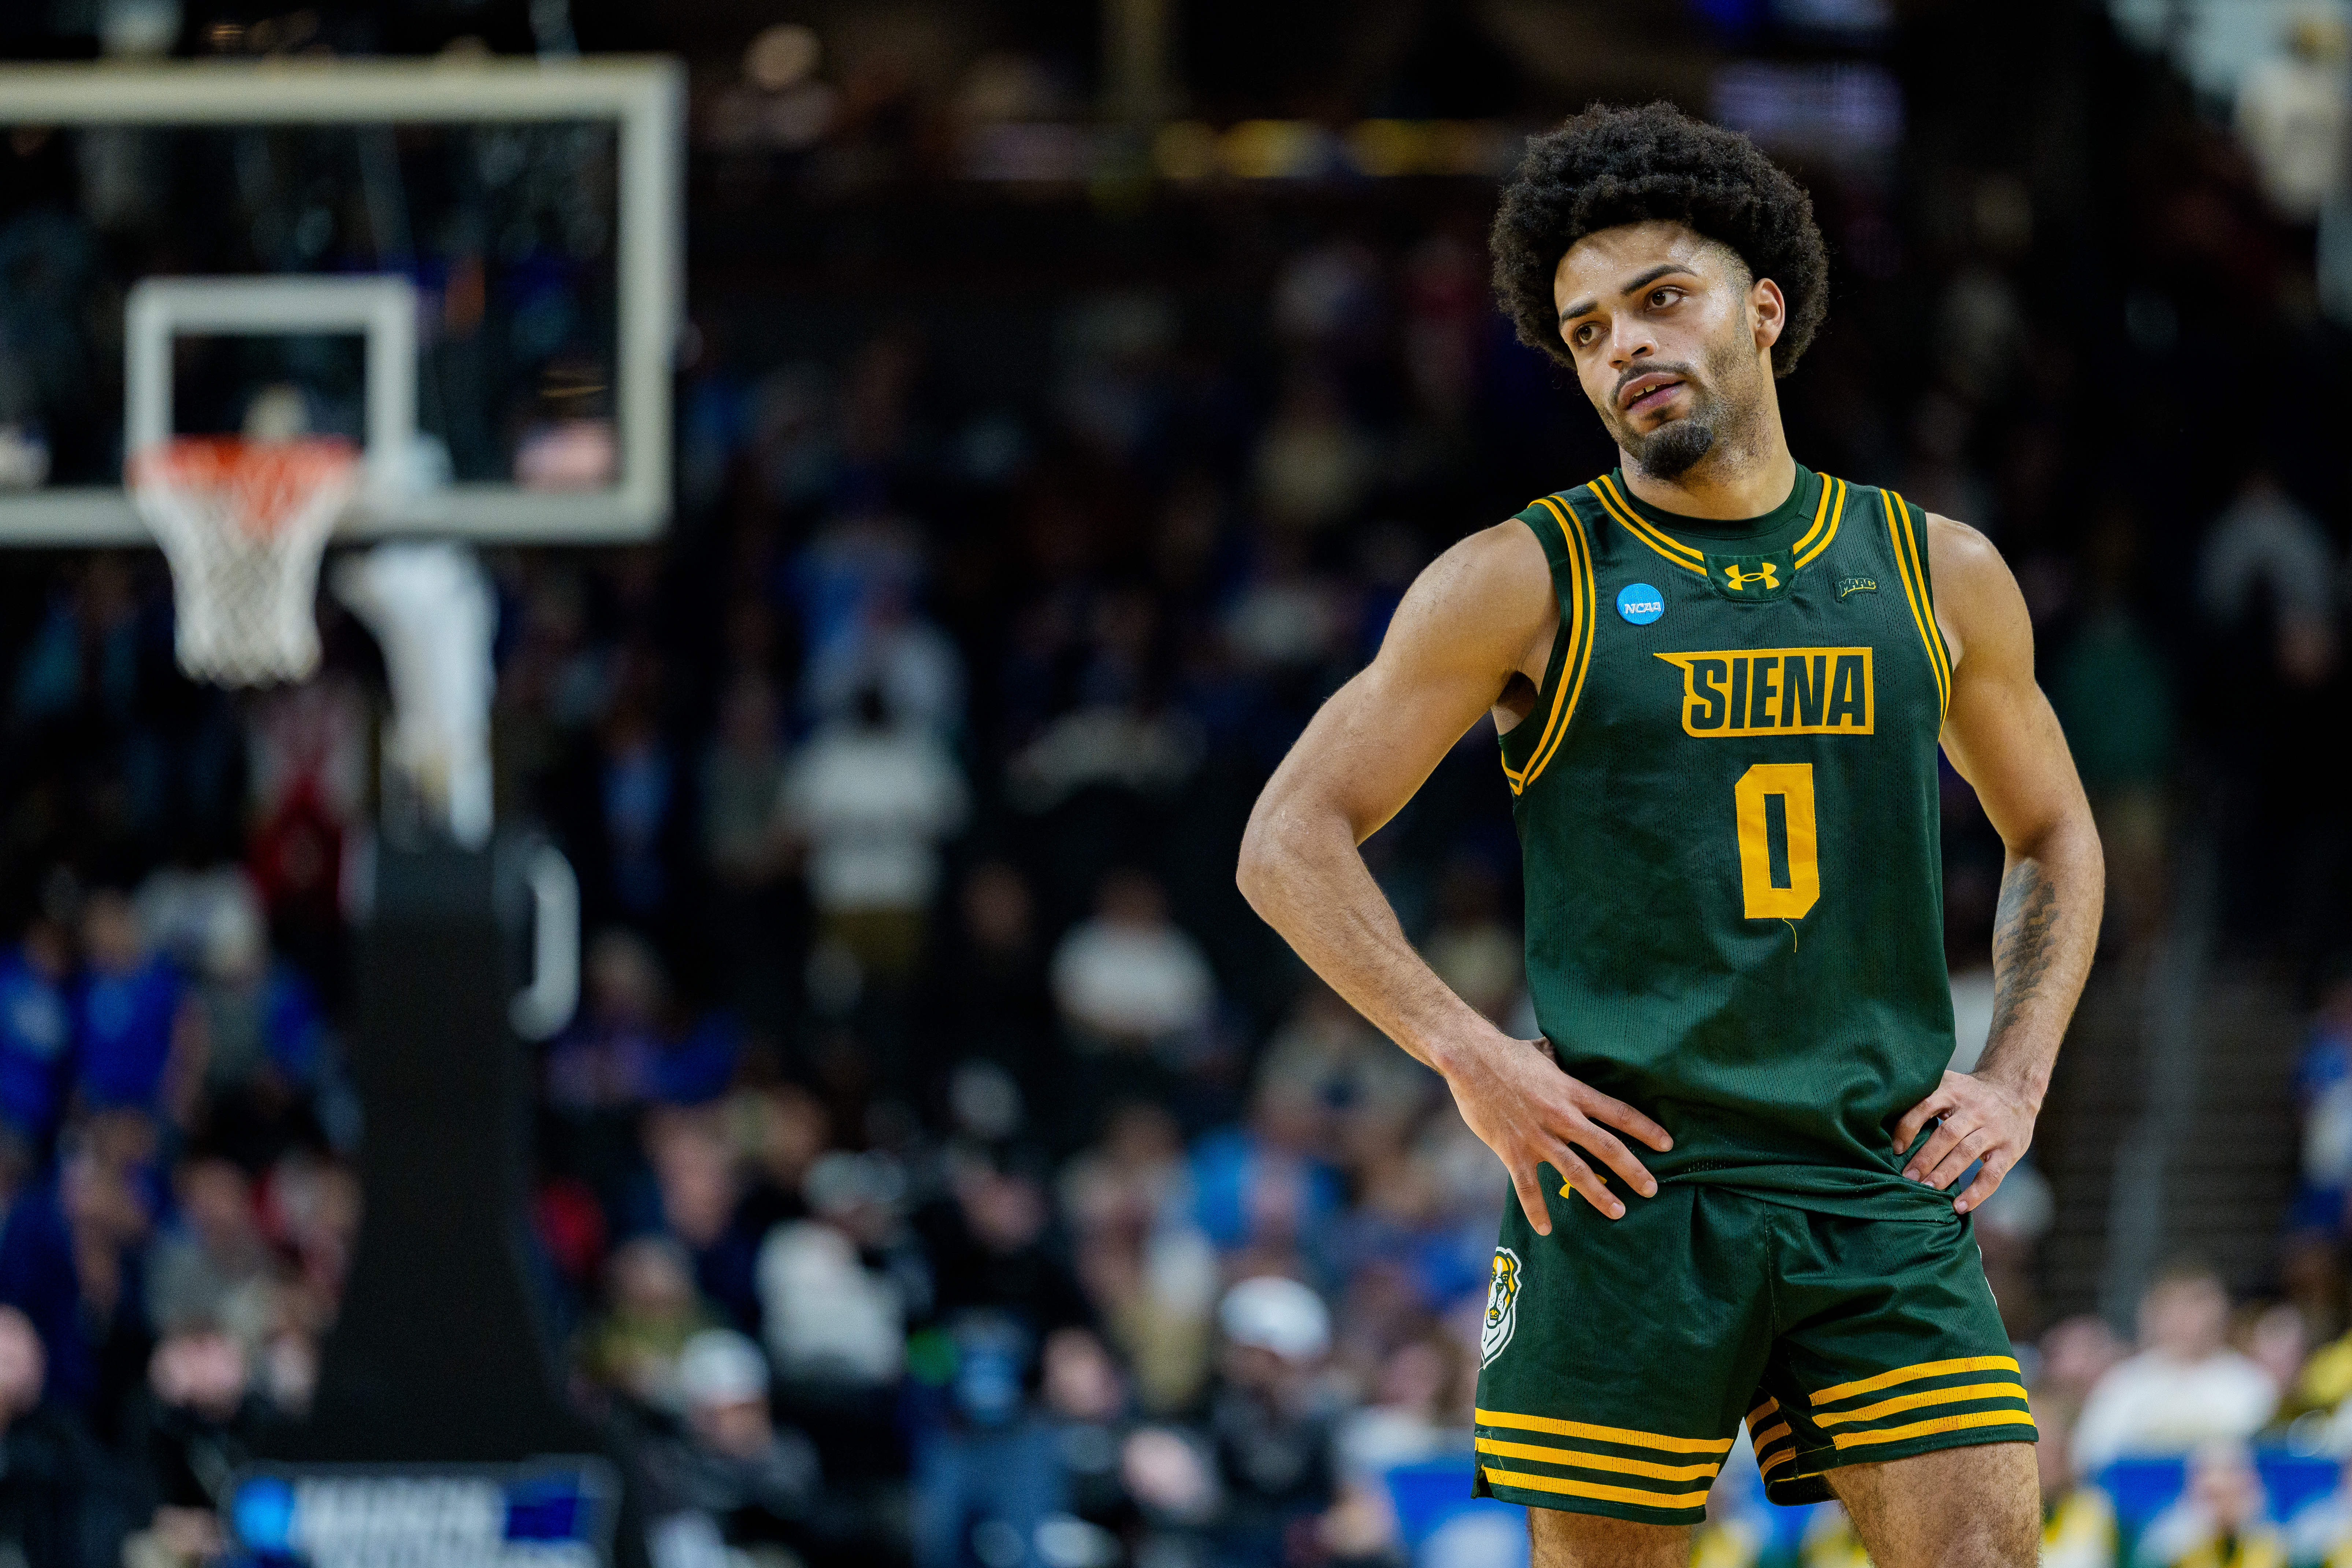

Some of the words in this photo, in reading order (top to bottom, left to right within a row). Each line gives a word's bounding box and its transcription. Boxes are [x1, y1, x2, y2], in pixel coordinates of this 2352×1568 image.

[1624, 602, 1661, 614] NCAA
[1839, 578, 1876, 597] MAAC
[1685, 655, 1865, 730] SIENA
[1735, 763, 1820, 919] 0
